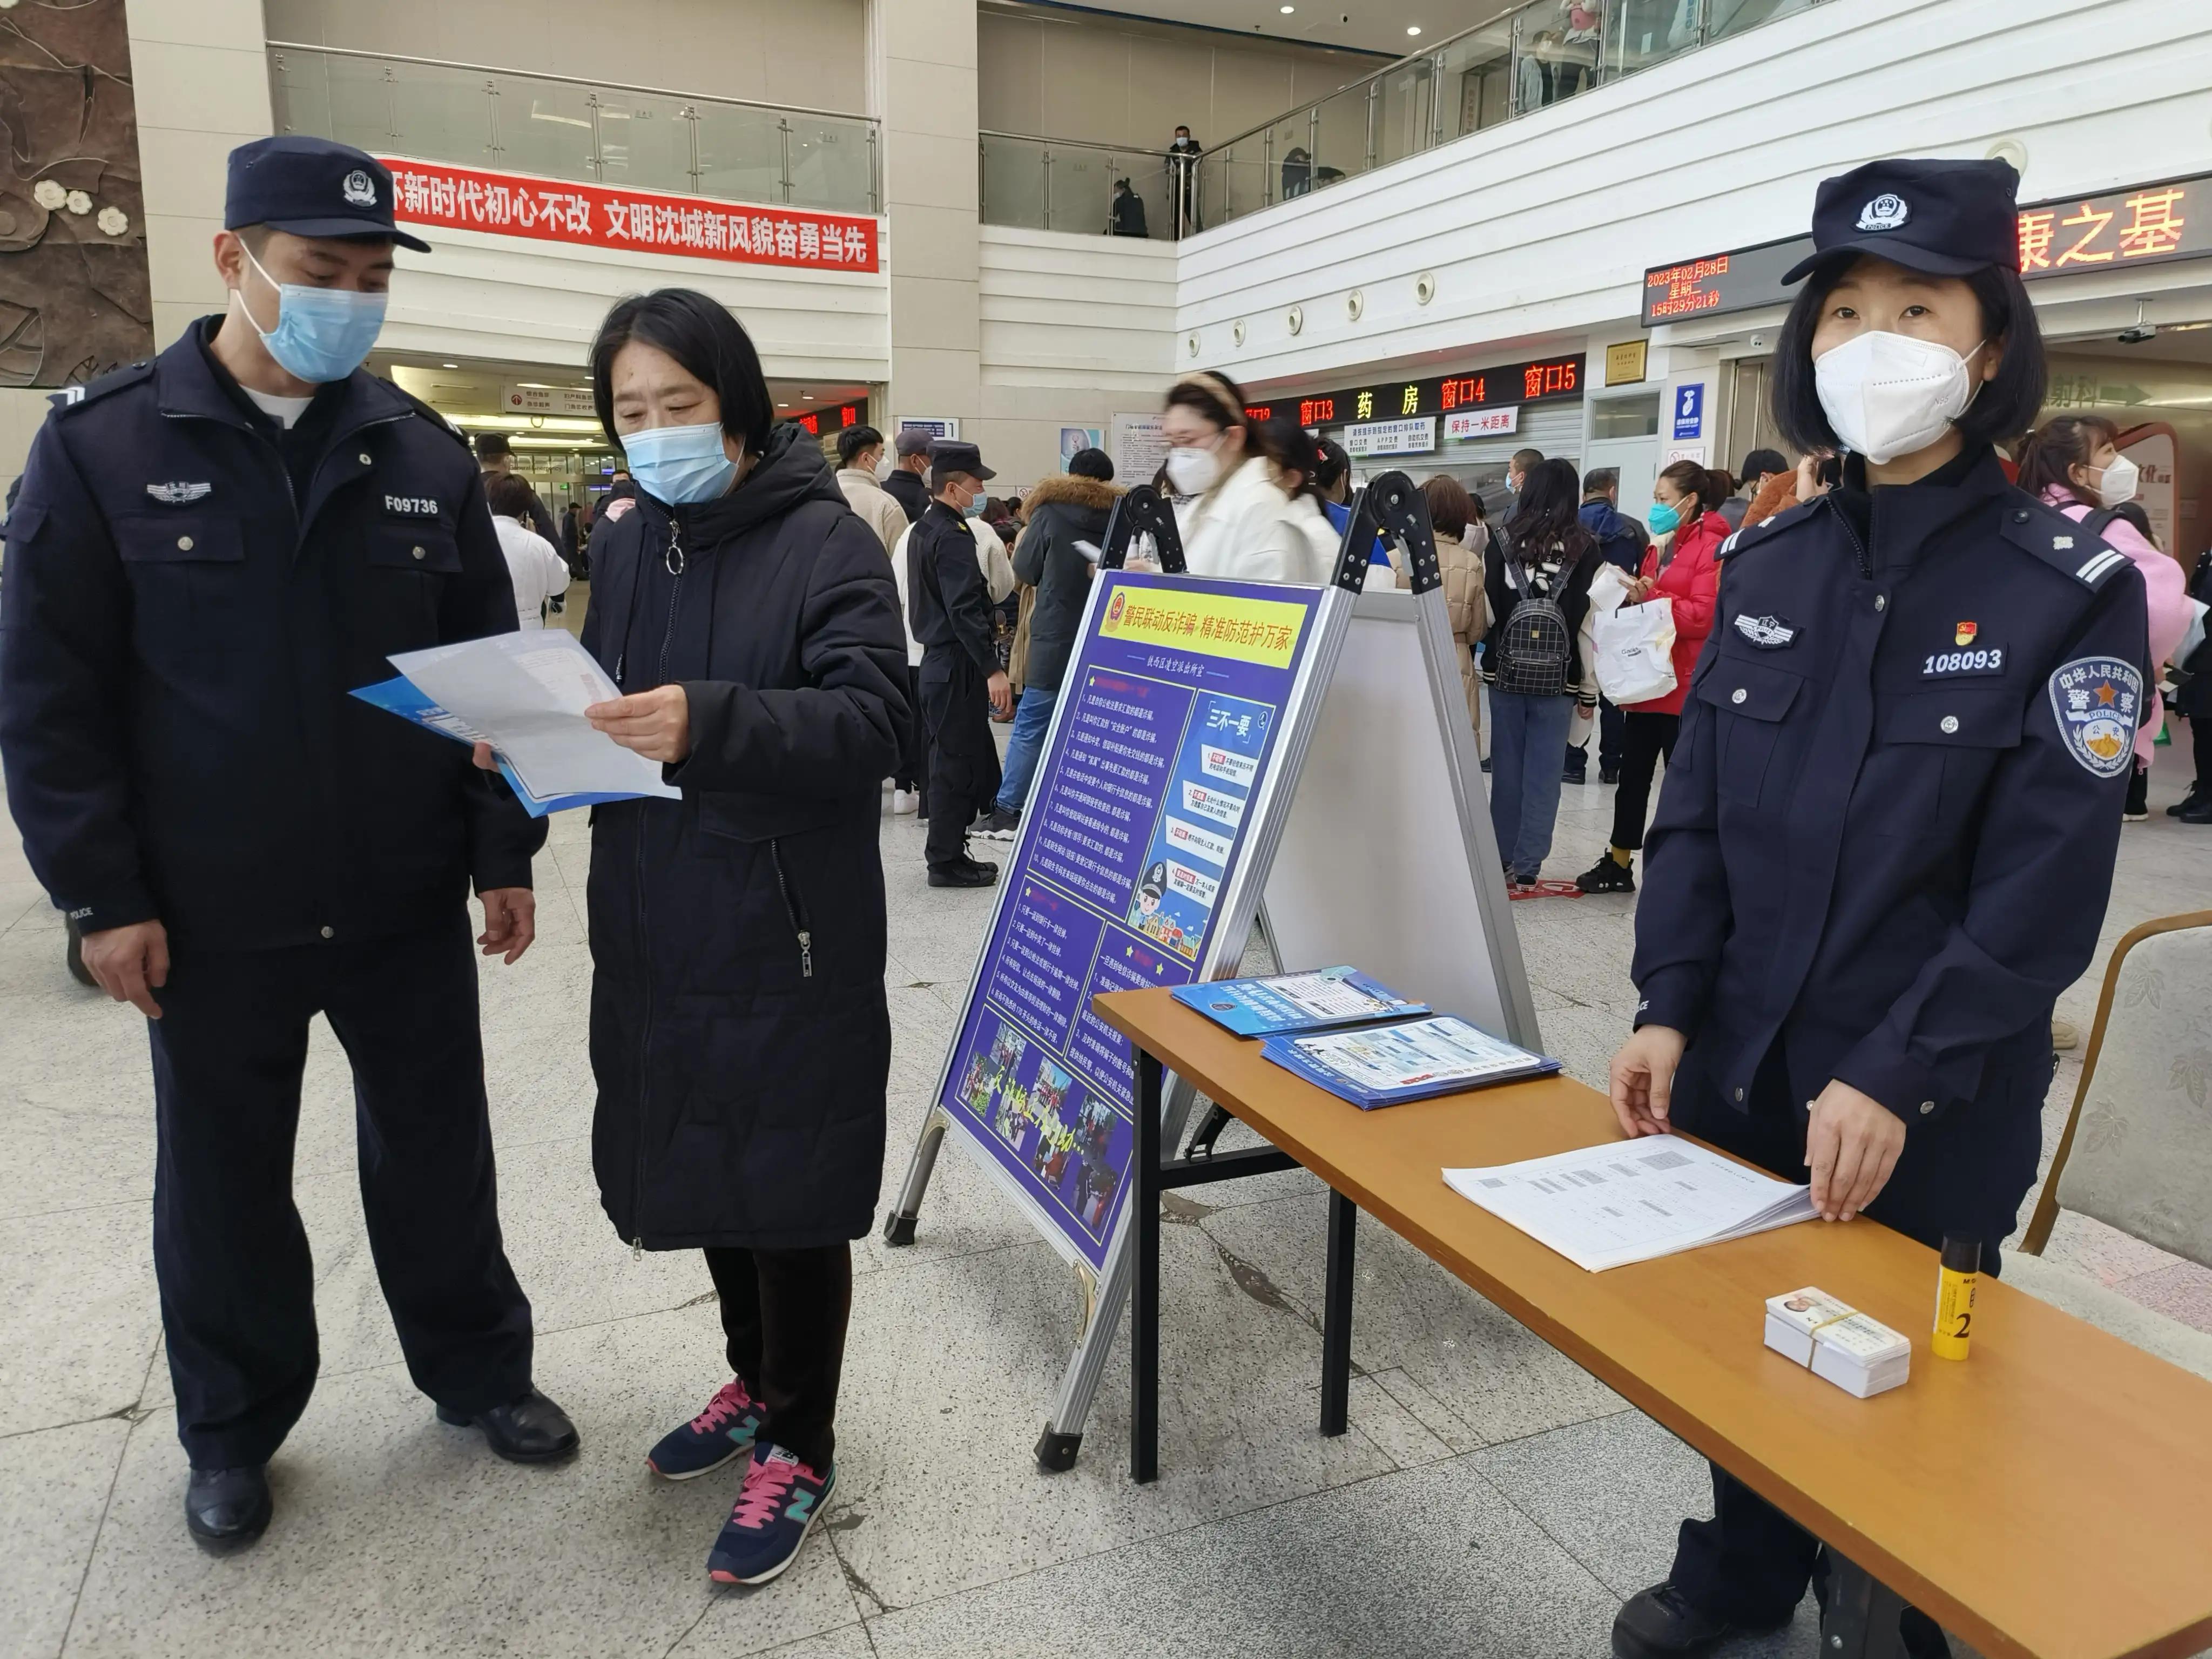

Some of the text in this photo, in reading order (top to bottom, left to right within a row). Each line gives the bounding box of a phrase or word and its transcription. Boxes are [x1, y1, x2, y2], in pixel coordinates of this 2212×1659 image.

[604, 200, 867, 262] 文明沈城新风貌奋勇当先
[1648, 256, 1729, 287] 2023年02月28日
[1669, 279, 1702, 299] 星期二
[1651, 290, 1720, 316] 15时29分21秒
[1300, 400, 1334, 426] 窗口3
[1442, 378, 1485, 409] 窗口4
[1525, 362, 1576, 399] 窗口5
[1452, 414, 1510, 434] 保持一米距离
[385, 495, 439, 514] F09736
[1124, 604, 1293, 651] 警民联动反诈骗 精准防范护万家
[1147, 655, 1204, 677] 铁西区凌空派出所宣
[1923, 649, 2001, 674] 108093
[2059, 664, 2139, 693] 中华人民共和国
[1206, 709, 1252, 737] 三不一要
[2088, 710, 2121, 721] POLICE
[70, 907, 93, 920] POLICE
[1953, 1313, 1971, 1338] 2
